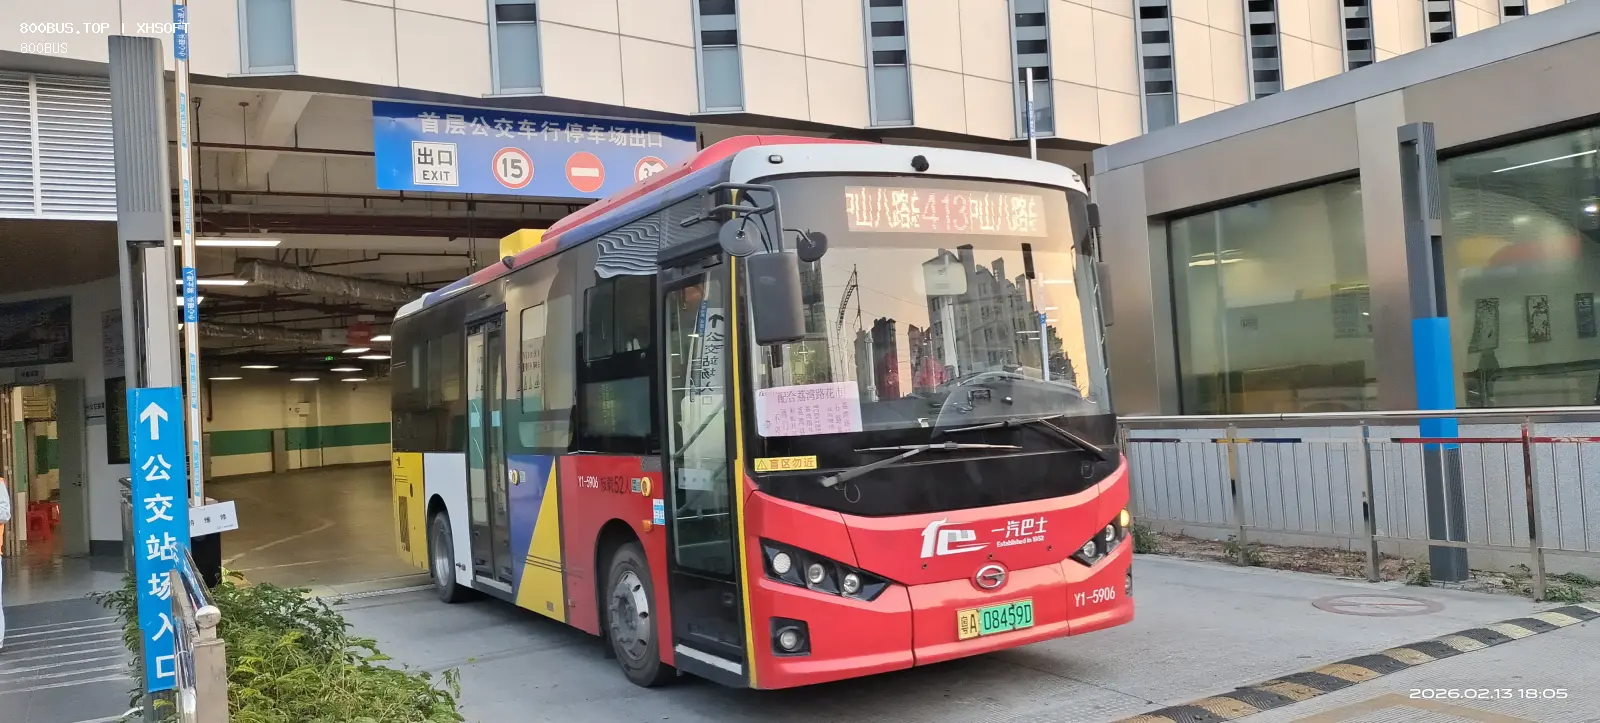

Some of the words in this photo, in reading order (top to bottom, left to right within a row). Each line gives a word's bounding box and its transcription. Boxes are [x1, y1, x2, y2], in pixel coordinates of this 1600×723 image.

[418, 111, 664, 148] 首层公交车行停车场出口
[417, 147, 453, 167] 出口
[502, 157, 524, 179] 15
[422, 169, 451, 182] EXIT
[922, 192, 970, 231] 413
[769, 457, 814, 469] 盲区勿近
[991, 517, 1048, 538] 一汽巴士
[142, 454, 177, 678] 公交站场入口
[1074, 586, 1116, 608] Y1-5906
[983, 604, 1032, 631] 08459D
